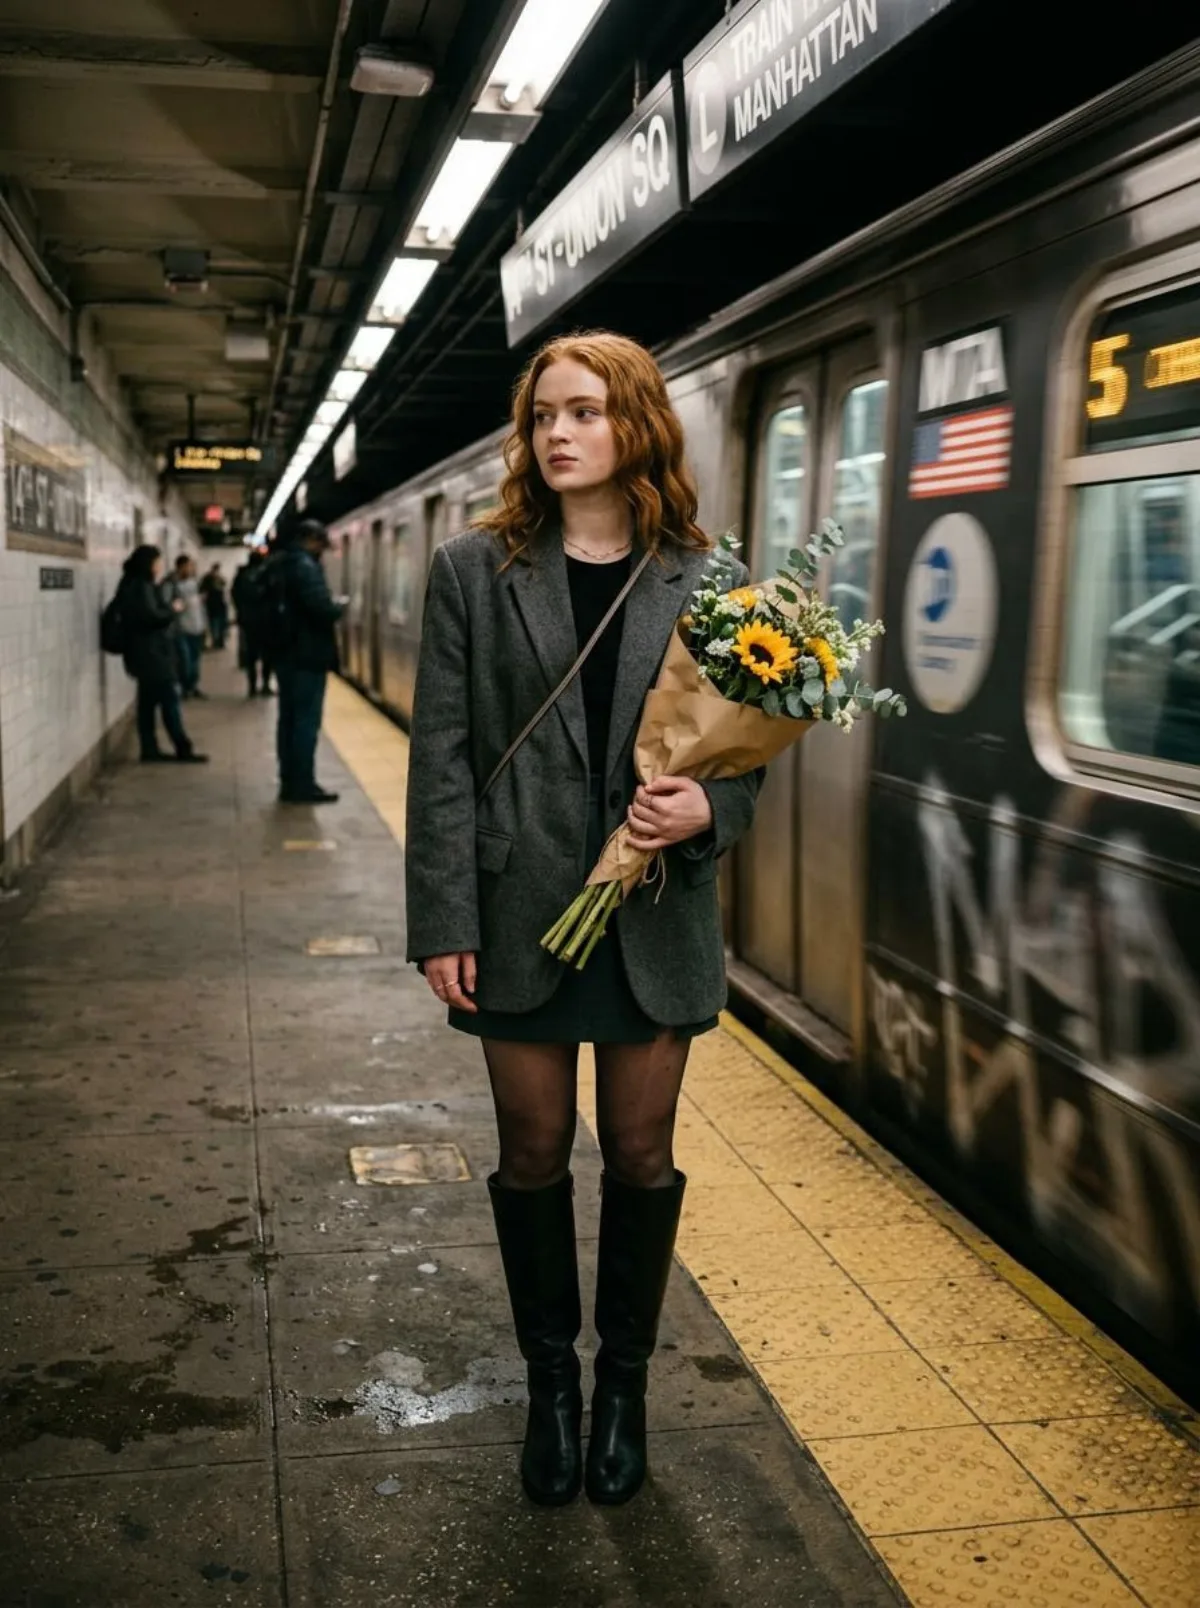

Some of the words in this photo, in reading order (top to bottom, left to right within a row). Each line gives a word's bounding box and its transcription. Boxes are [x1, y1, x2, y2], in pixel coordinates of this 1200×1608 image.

[730, 0, 793, 81] TRAIN
[733, 0, 878, 142] MANHATTAN
[631, 114, 671, 208] SQ
[699, 91, 719, 153] L
[1086, 333, 1130, 419] 5
